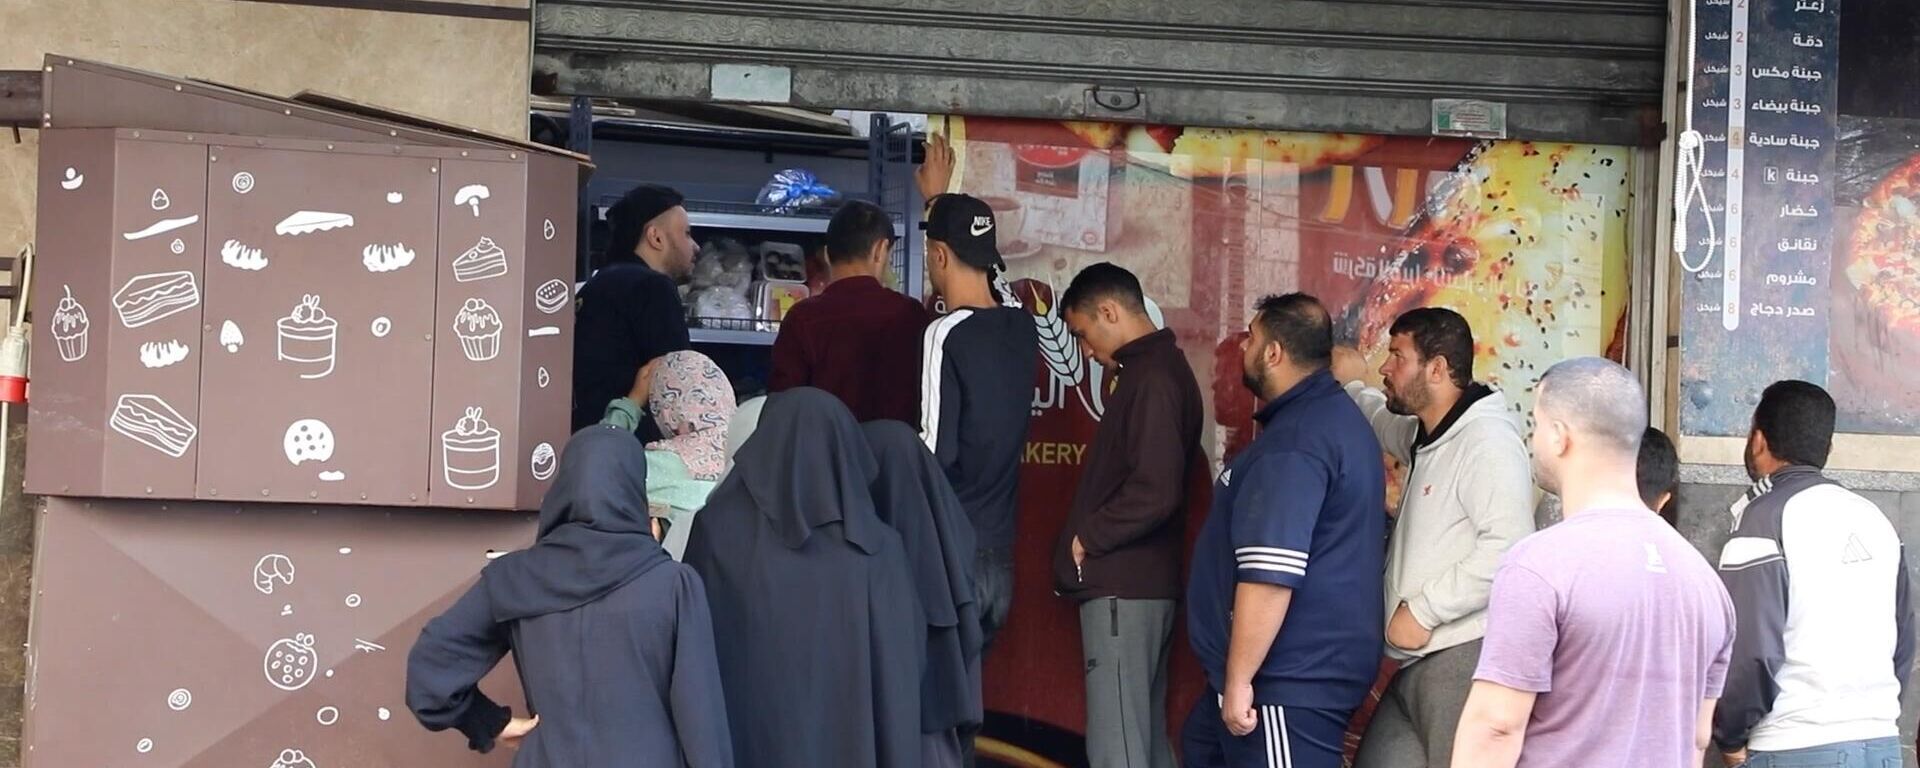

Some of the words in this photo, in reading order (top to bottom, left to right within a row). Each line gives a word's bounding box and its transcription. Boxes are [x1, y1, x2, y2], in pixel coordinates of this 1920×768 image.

[1704, 31, 1730, 40] شيكل
[1735, 32, 1744, 43] 2
[1792, 32, 1824, 48] دقة
[1703, 64, 1729, 74] شيكل
[1735, 65, 1742, 76] 3
[1752, 66, 1790, 79] مكس
[1791, 65, 1822, 82] جبنة
[1702, 98, 1727, 108] شيكل
[1733, 99, 1741, 109] 3
[1751, 99, 1789, 114] بيضاء
[1790, 98, 1821, 115] جبنة
[1749, 132, 1788, 148] سادية
[1789, 134, 1820, 149] جبنة
[1731, 169, 1739, 179] 4
[1786, 168, 1819, 184] جبنة
[1731, 203, 1738, 214] 6
[1780, 204, 1818, 217] خضار
[974, 215, 991, 226] NIKE
[1730, 237, 1737, 248] 6
[1777, 238, 1817, 252] نقانق
[1729, 270, 1736, 281] 6
[1766, 270, 1817, 285] مشروم
[1696, 303, 1721, 312] شيكل
[1728, 303, 1735, 314] 8
[1750, 302, 1783, 317] دجاج
[1786, 305, 1815, 318] صدر
[1021, 442, 1087, 464] KERY
